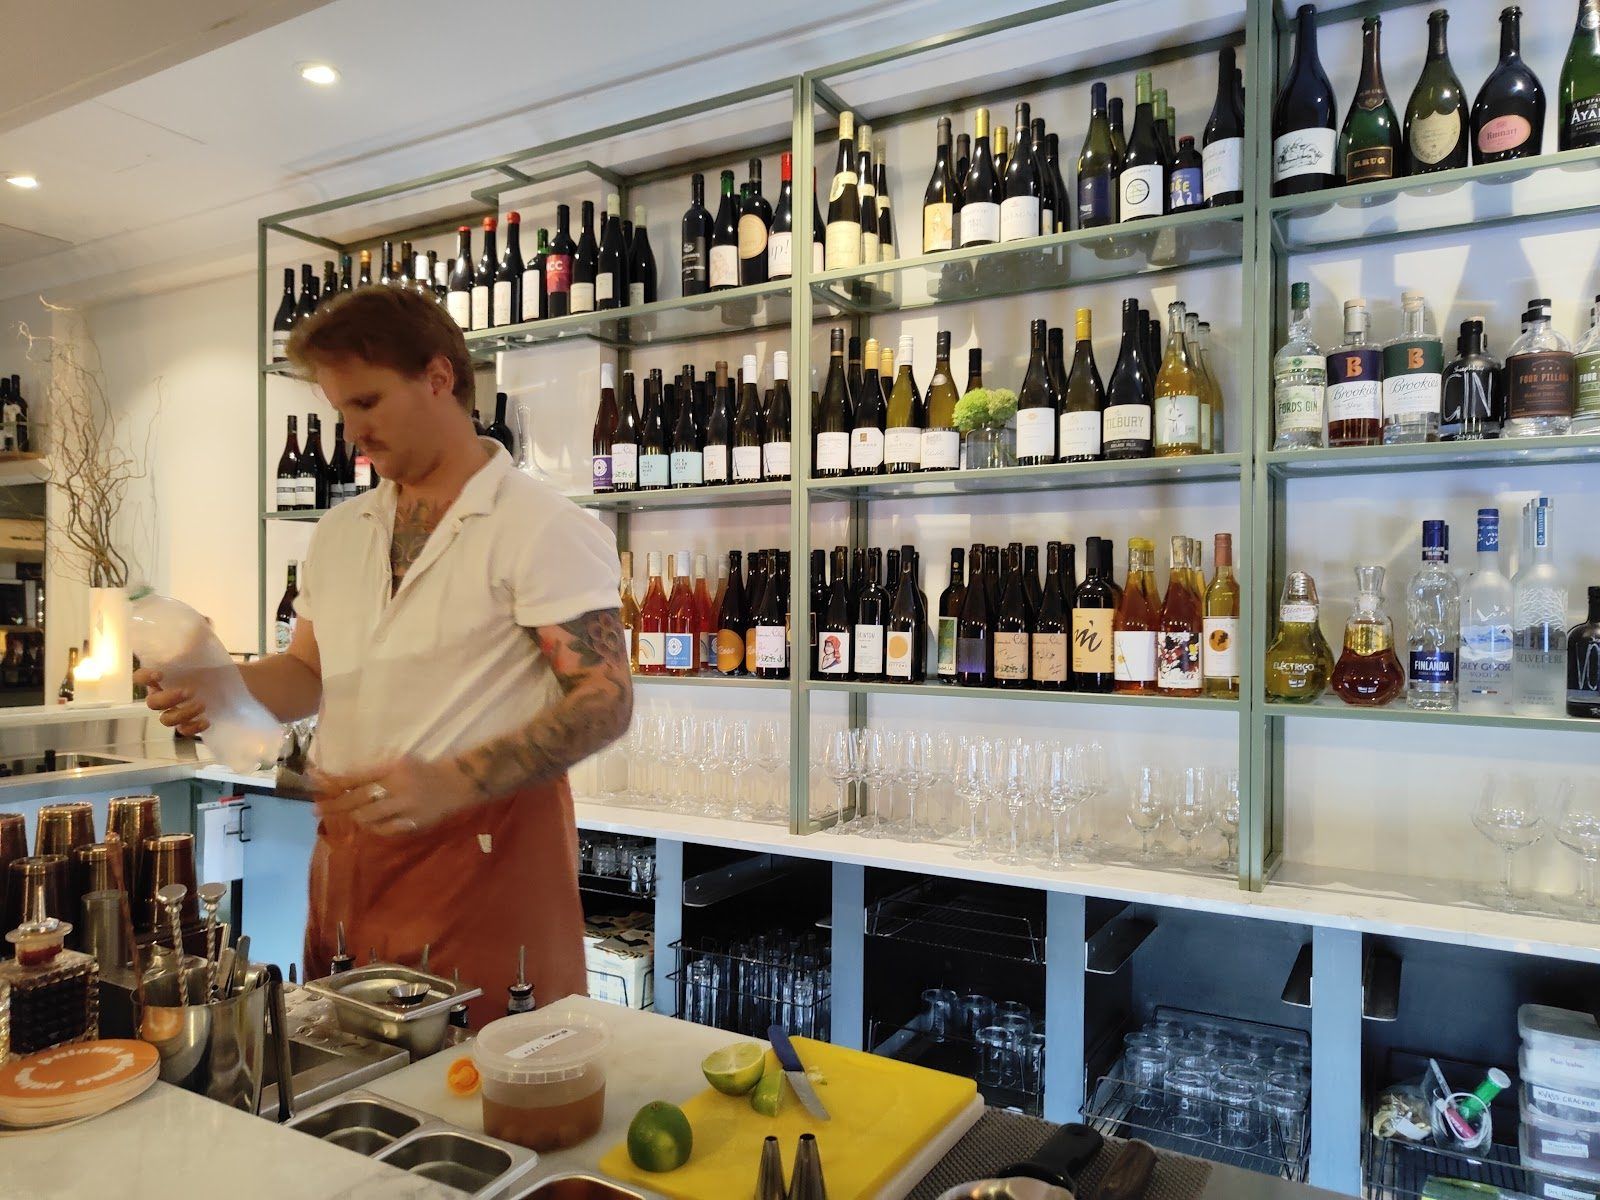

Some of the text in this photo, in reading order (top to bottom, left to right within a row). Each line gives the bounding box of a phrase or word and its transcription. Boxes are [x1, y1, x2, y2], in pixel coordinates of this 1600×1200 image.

[1353, 156, 1386, 168] KRUG
[1406, 347, 1425, 370] B
[1345, 356, 1363, 378] B
[1519, 374, 1537, 385] FOUR
[1278, 400, 1318, 415] FORDS GIN
[1105, 416, 1145, 431] TILBURY
[1414, 660, 1450, 672] FINLANDIA
